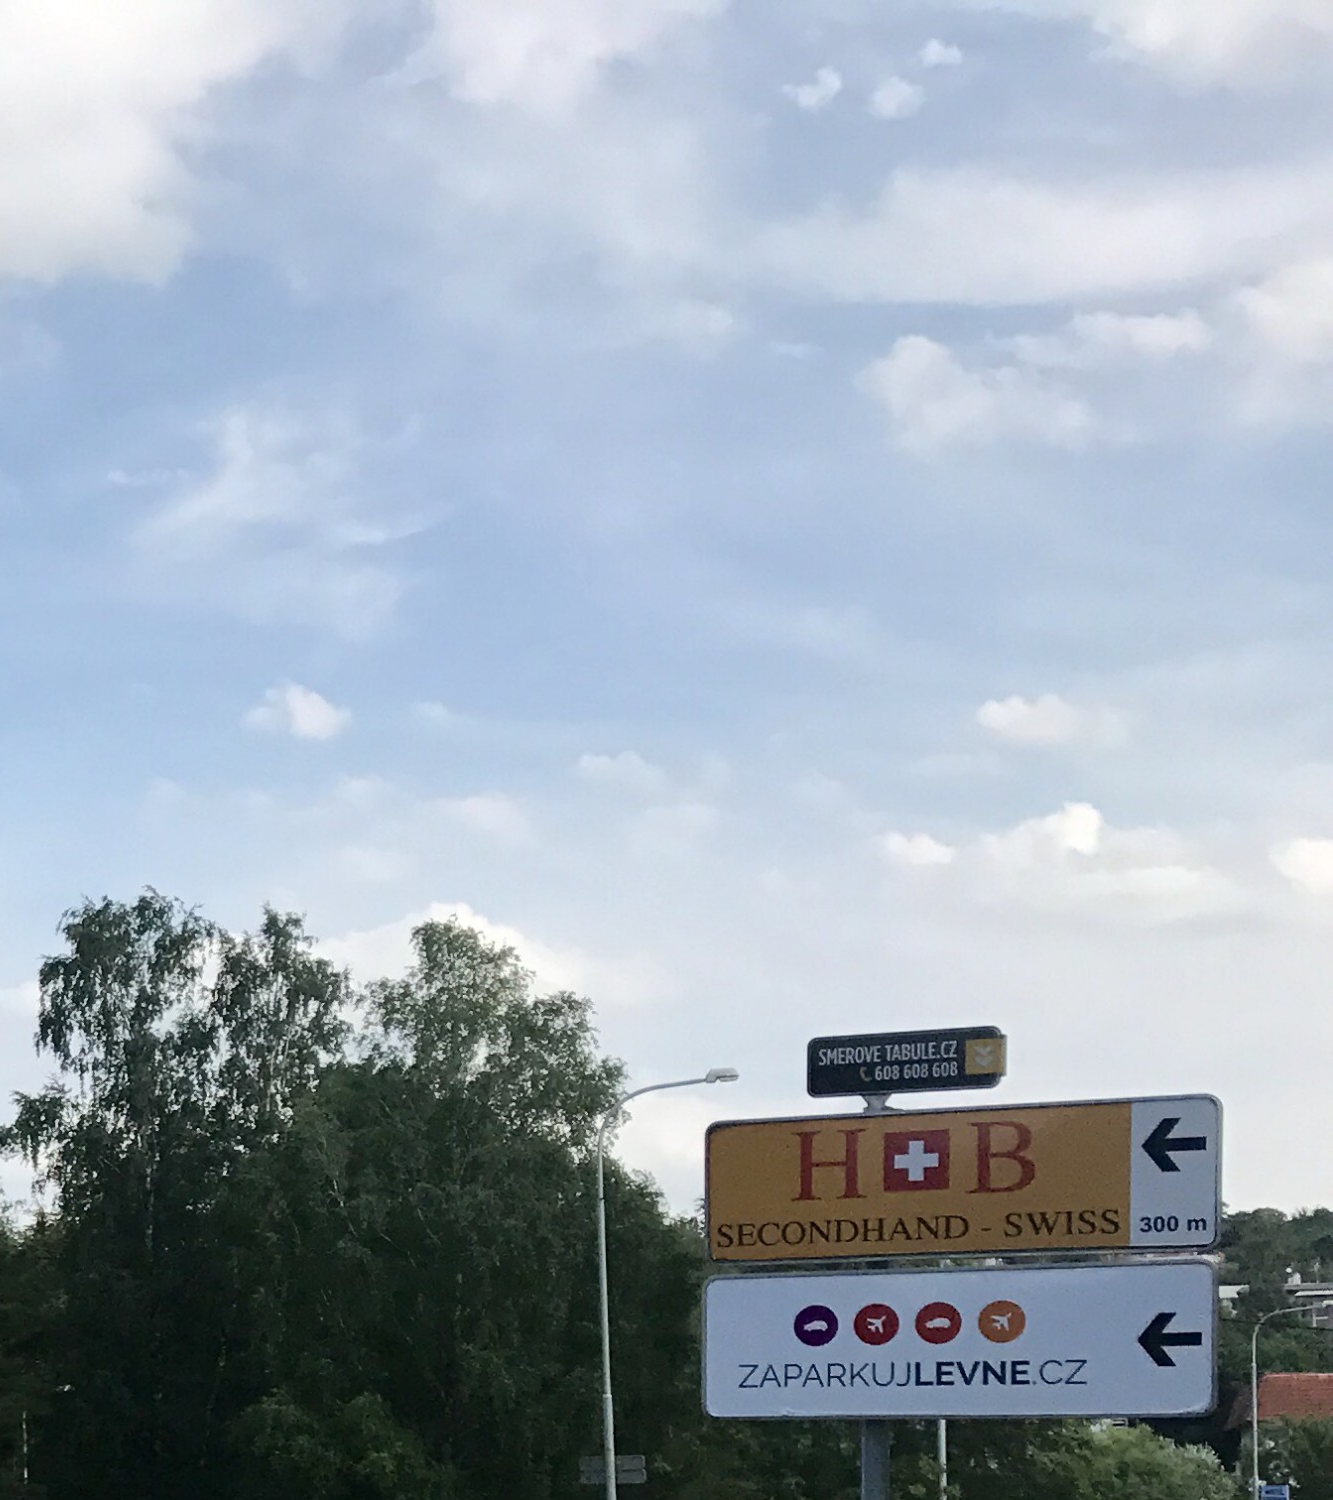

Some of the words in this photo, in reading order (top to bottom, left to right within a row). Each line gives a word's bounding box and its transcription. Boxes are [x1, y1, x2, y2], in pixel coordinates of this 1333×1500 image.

[818, 1045, 881, 1066] SMEROVE
[884, 1040, 958, 1061] TABULE.CZ
[874, 1065, 900, 1081] 608
[903, 1063, 929, 1079] 608
[932, 1061, 958, 1077] 608
[790, 1128, 869, 1201] H
[965, 1120, 1037, 1195] B
[716, 1214, 970, 1249] SECONDHAND
[1003, 1208, 1121, 1239] SWISS
[1139, 1215, 1179, 1233] 300
[1184, 1217, 1208, 1232] m
[737, 1358, 1088, 1389] ZAPARKUJLEVNE.CZ
